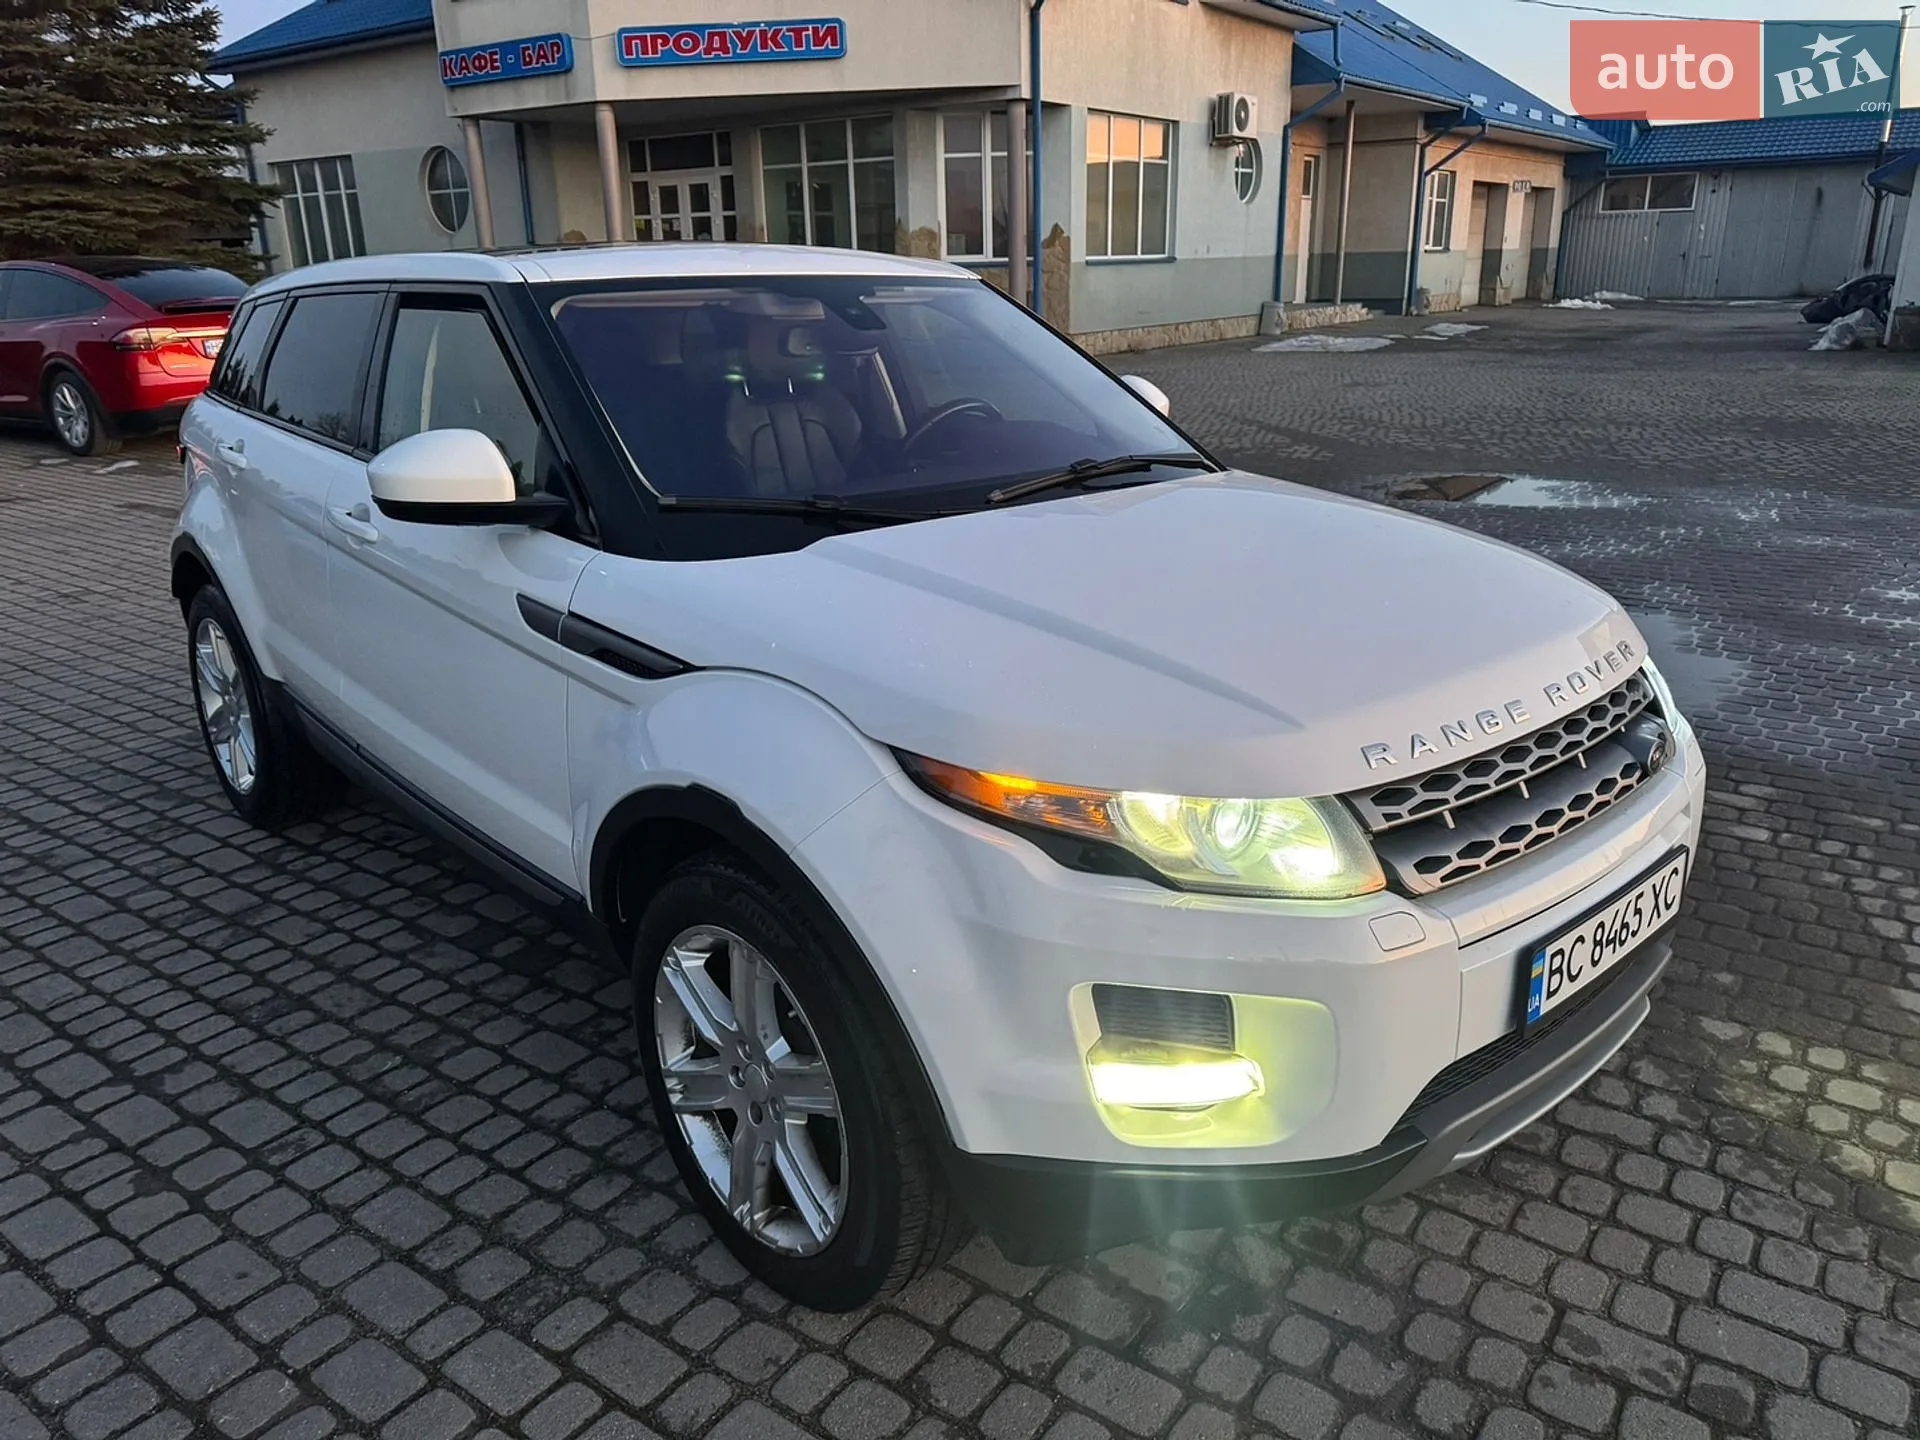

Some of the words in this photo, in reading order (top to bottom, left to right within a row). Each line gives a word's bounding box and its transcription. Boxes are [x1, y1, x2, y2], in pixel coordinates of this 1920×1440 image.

[440, 47, 502, 79] КАФЕ
[519, 38, 563, 69] БАР
[622, 23, 840, 59] ПРОДУКТИ
[1360, 699, 1532, 770] RANGE
[1542, 639, 1635, 708] ROVER
[1546, 934, 1586, 1001] BC
[1590, 891, 1645, 968] 8465
[1646, 866, 1679, 929] XC
[1527, 993, 1541, 1013] UA
